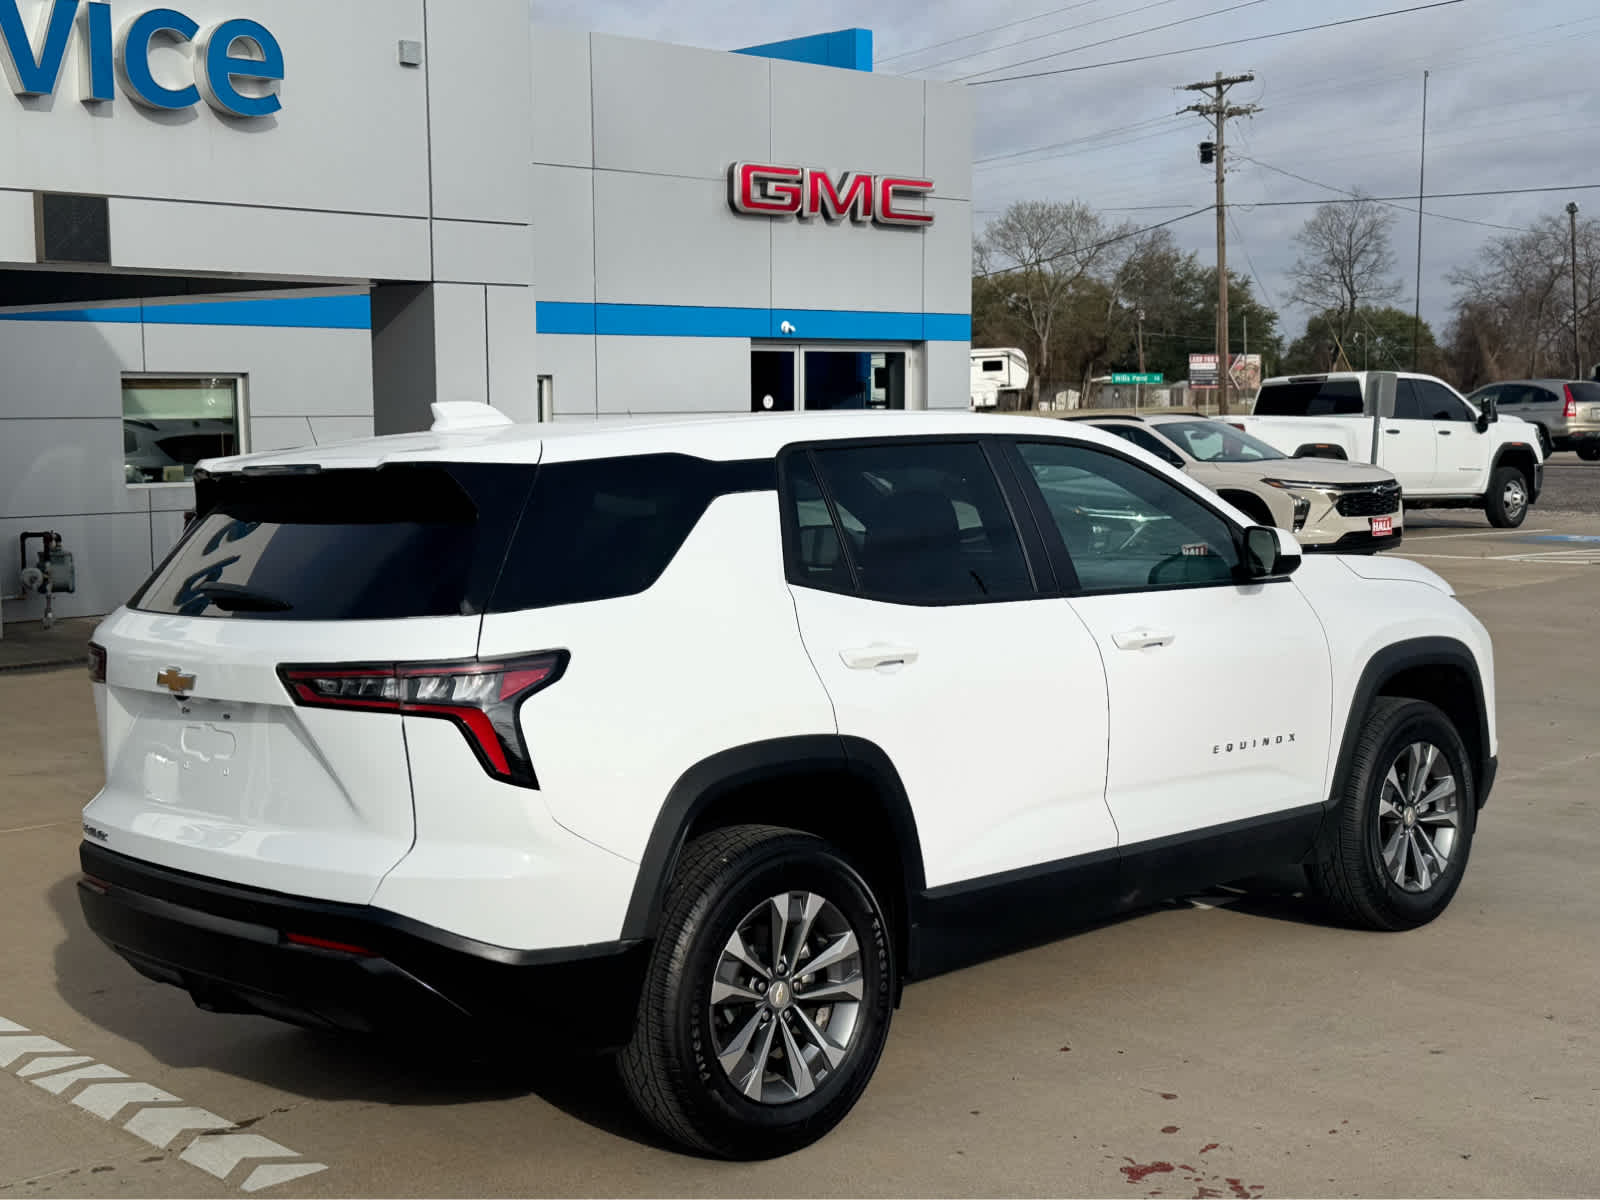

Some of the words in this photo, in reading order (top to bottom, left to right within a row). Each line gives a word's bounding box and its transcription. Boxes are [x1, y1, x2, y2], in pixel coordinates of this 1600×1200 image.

[0, 0, 285, 117] vice
[733, 161, 935, 226] GMC
[1373, 519, 1392, 531] HALL
[1213, 733, 1295, 754] EQUINOX
